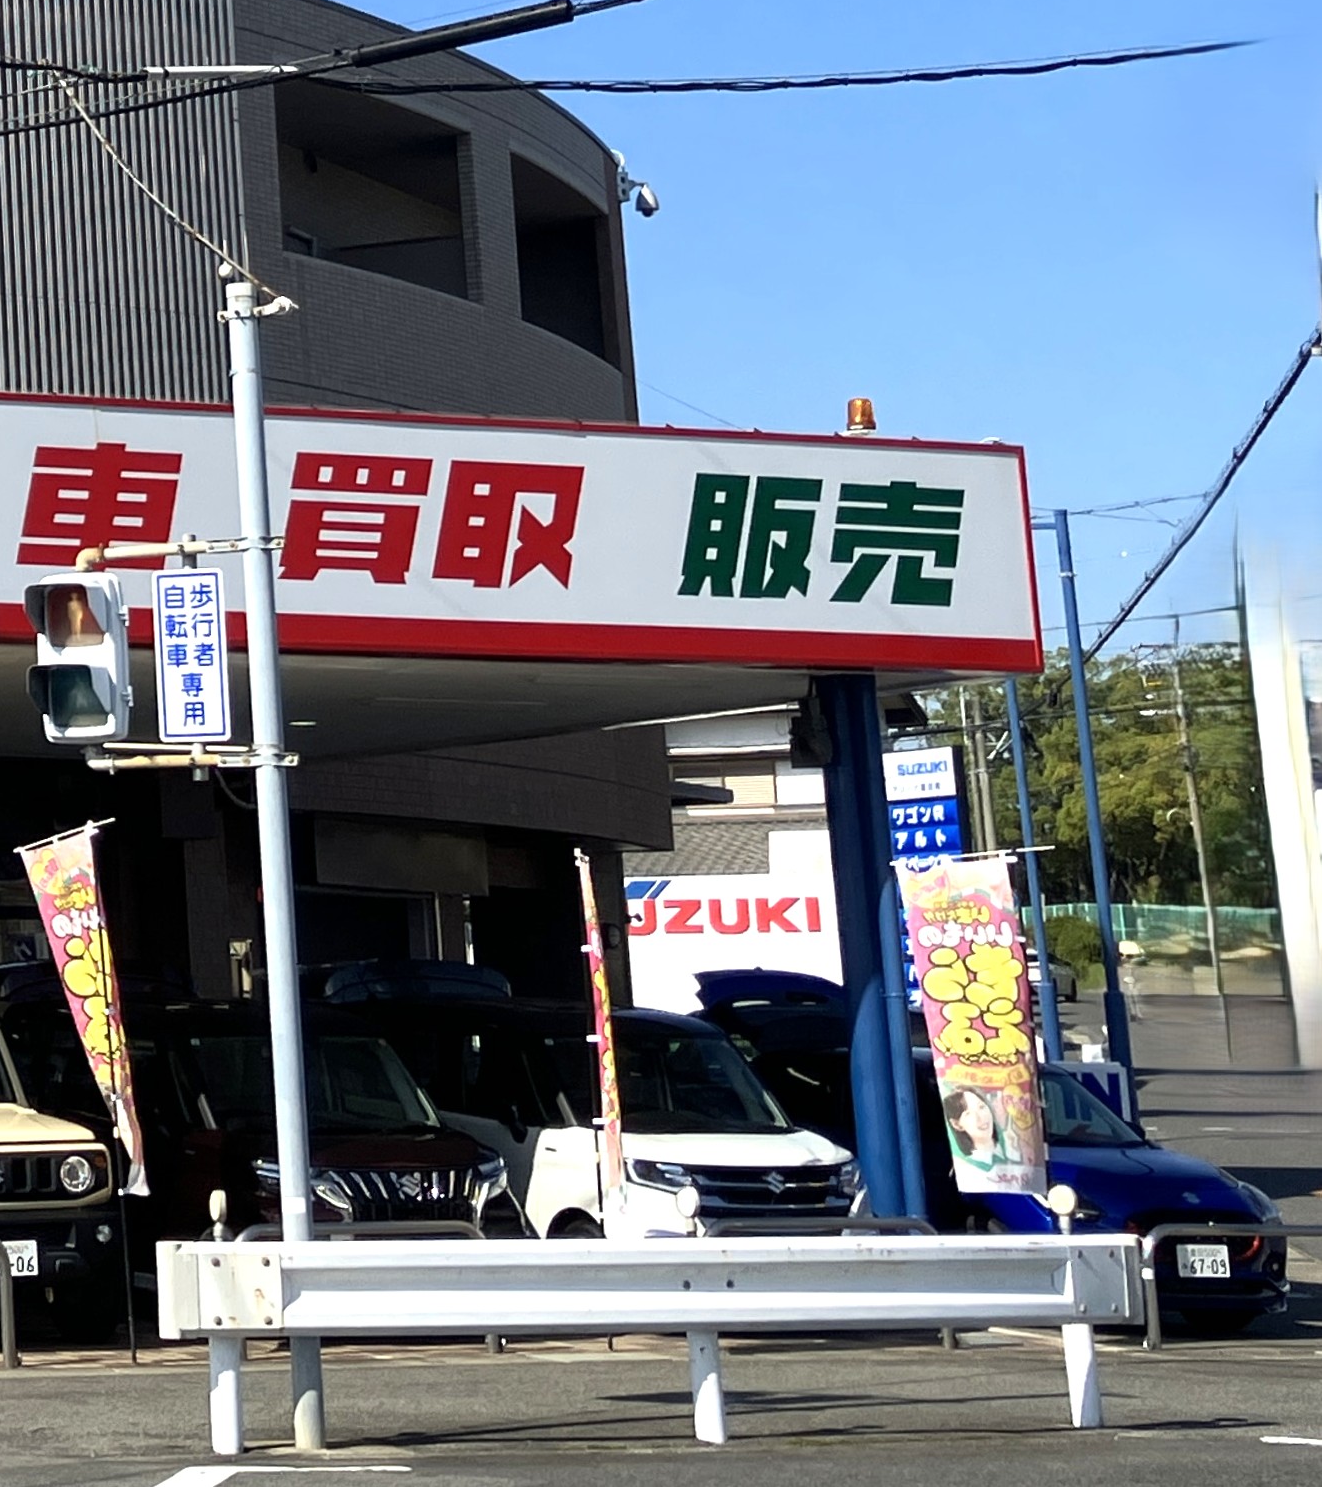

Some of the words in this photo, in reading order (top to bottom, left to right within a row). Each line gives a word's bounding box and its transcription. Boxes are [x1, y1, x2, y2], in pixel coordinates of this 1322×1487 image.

[279, 452, 584, 589] 買取
[678, 481, 965, 606] 販売
[164, 584, 189, 668] 自転車
[190, 583, 215, 667] 歩行者
[181, 672, 205, 727] 専用
[897, 760, 948, 776] SUZUKI
[892, 804, 945, 825] ワゴンR
[894, 828, 947, 850] アルト
[627, 897, 821, 936] UZUKI
[1190, 1258, 1228, 1275] 67-09
